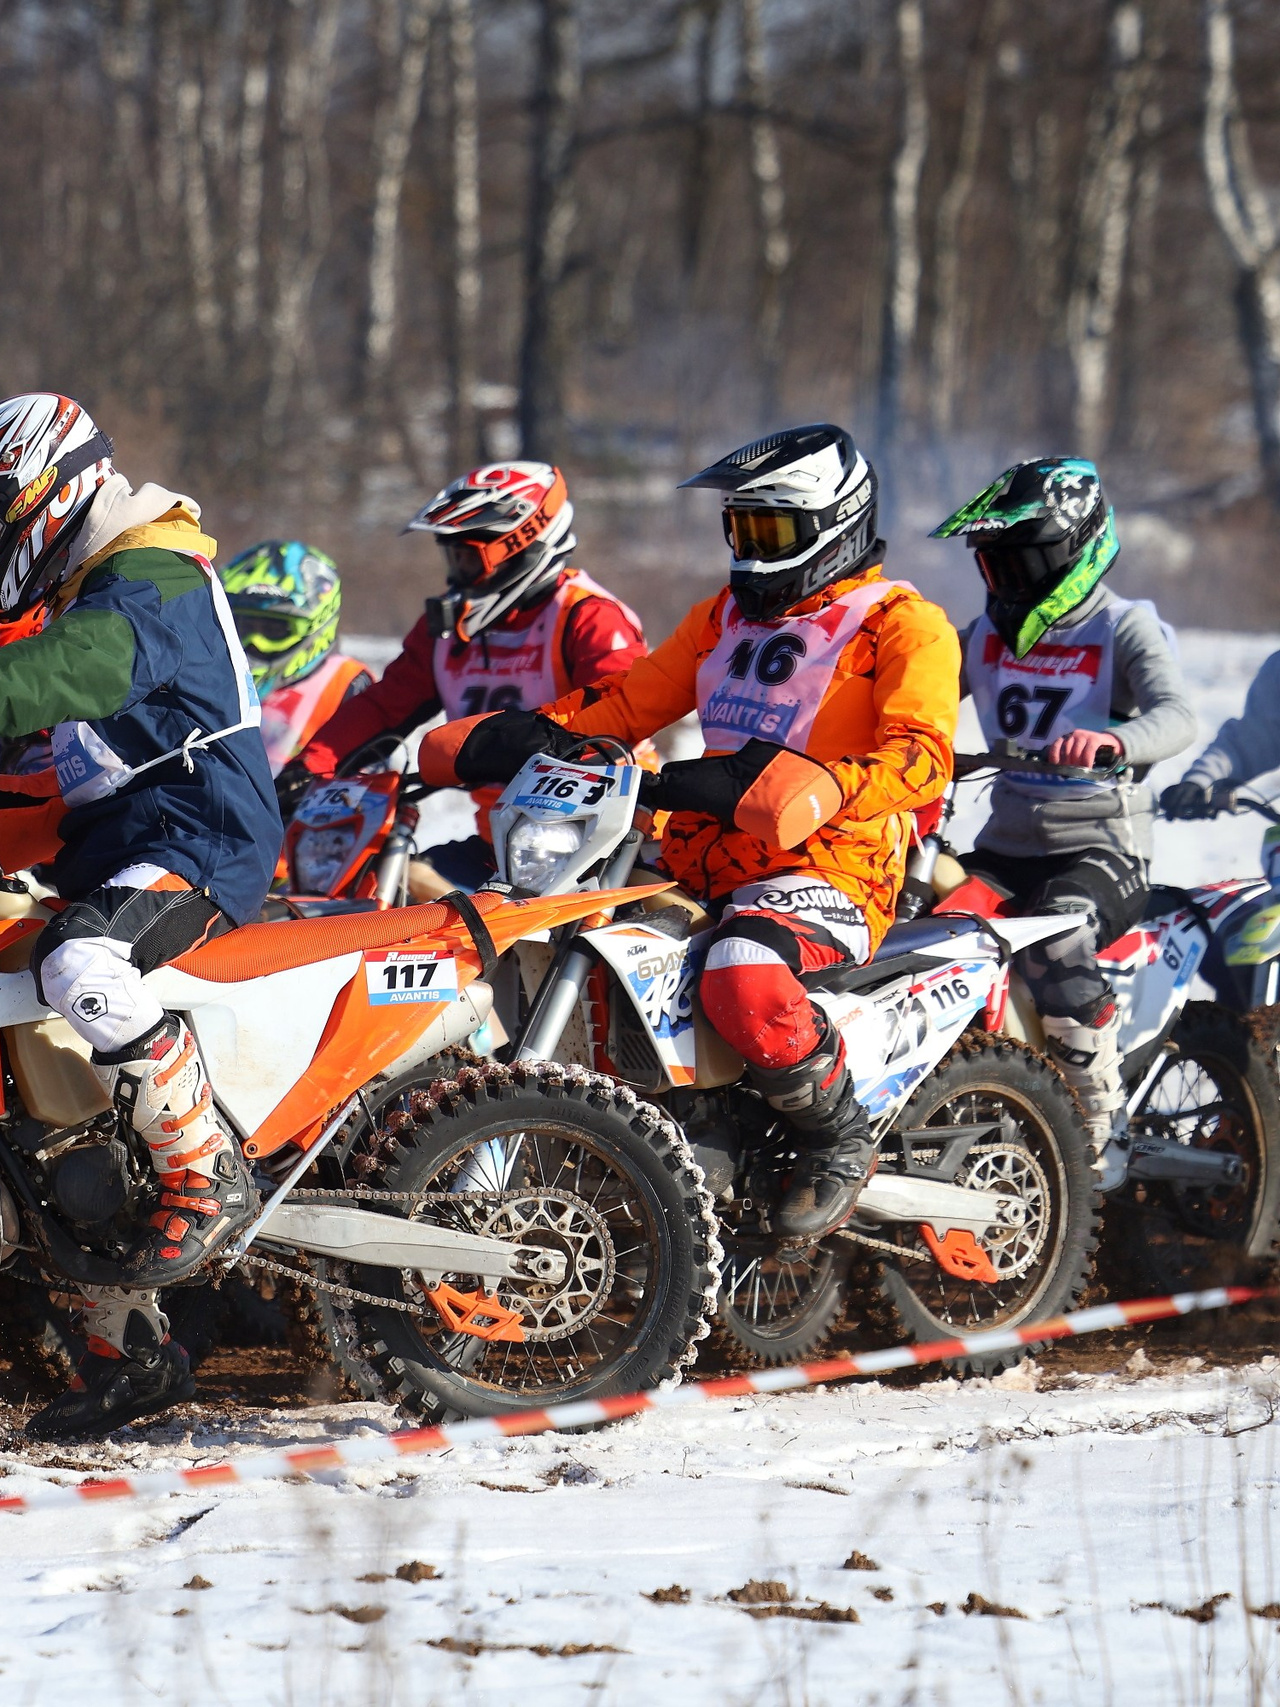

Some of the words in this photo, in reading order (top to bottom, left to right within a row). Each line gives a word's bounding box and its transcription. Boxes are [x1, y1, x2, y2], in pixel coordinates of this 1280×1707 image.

[958, 518, 1006, 535] Airoh
[726, 632, 808, 687] 16
[702, 701, 782, 734] AVANTIS
[997, 683, 1075, 741] 67
[530, 775, 580, 799] 116
[525, 796, 564, 809] AVANTIS
[626, 944, 648, 958] KTM
[1162, 936, 1186, 973] 67
[382, 962, 439, 990] 117
[389, 990, 441, 1003] AVANTIS
[930, 978, 971, 1010] 116
